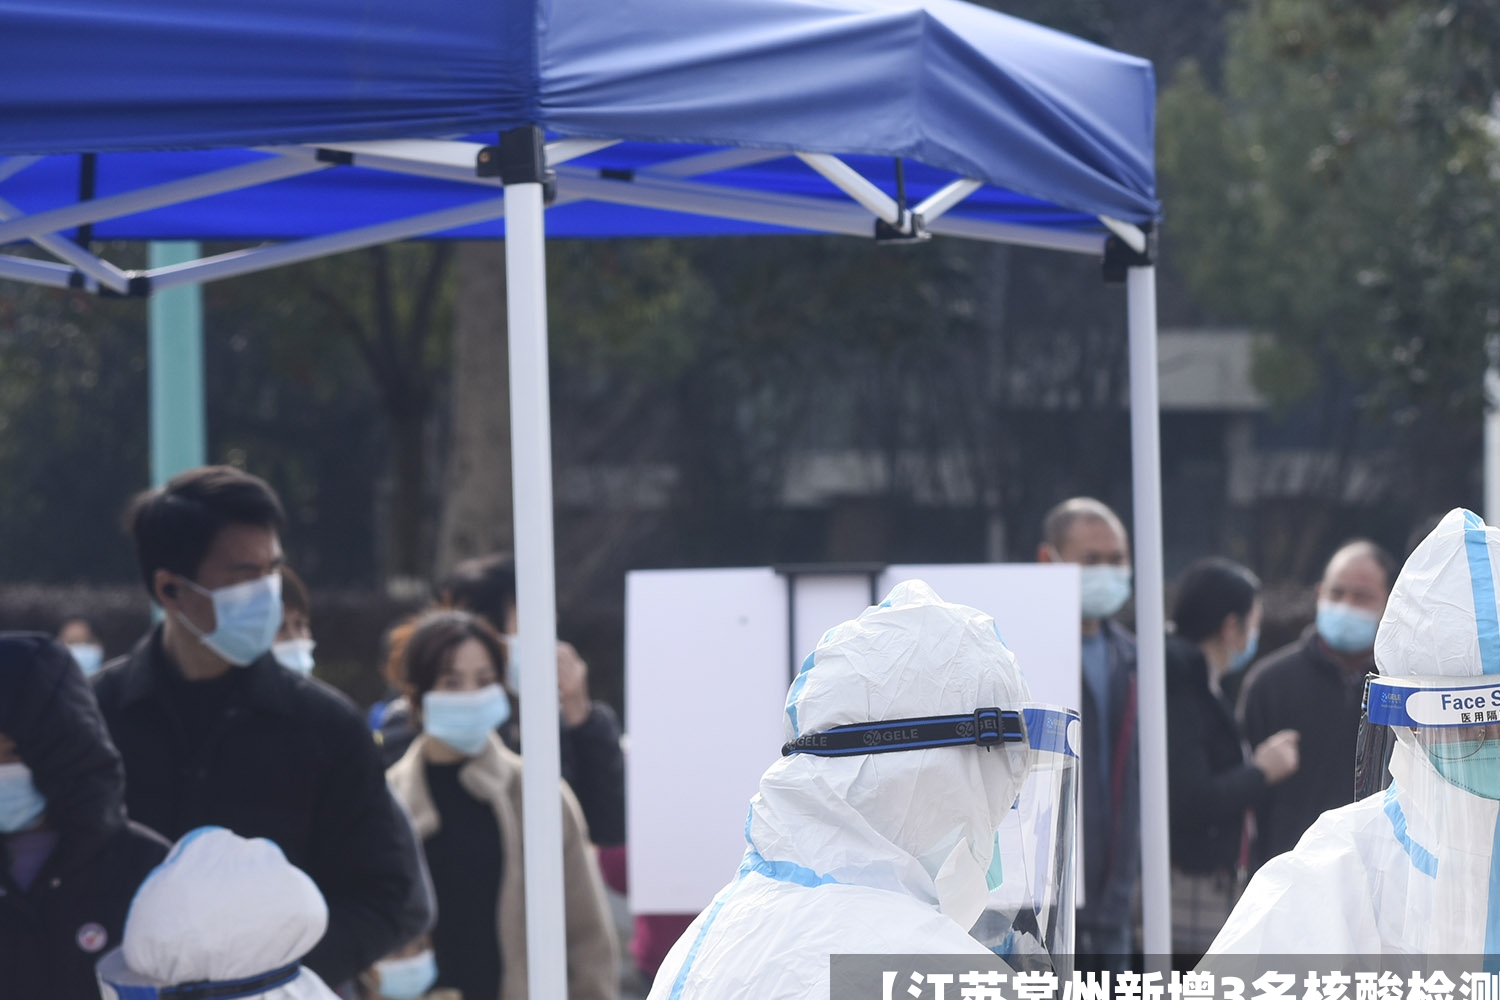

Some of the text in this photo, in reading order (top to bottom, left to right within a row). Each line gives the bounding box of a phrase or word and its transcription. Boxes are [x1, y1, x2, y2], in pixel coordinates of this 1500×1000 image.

[1441, 694, 1486, 711] Face
[796, 735, 828, 748] GELE
[882, 728, 920, 742] GELE
